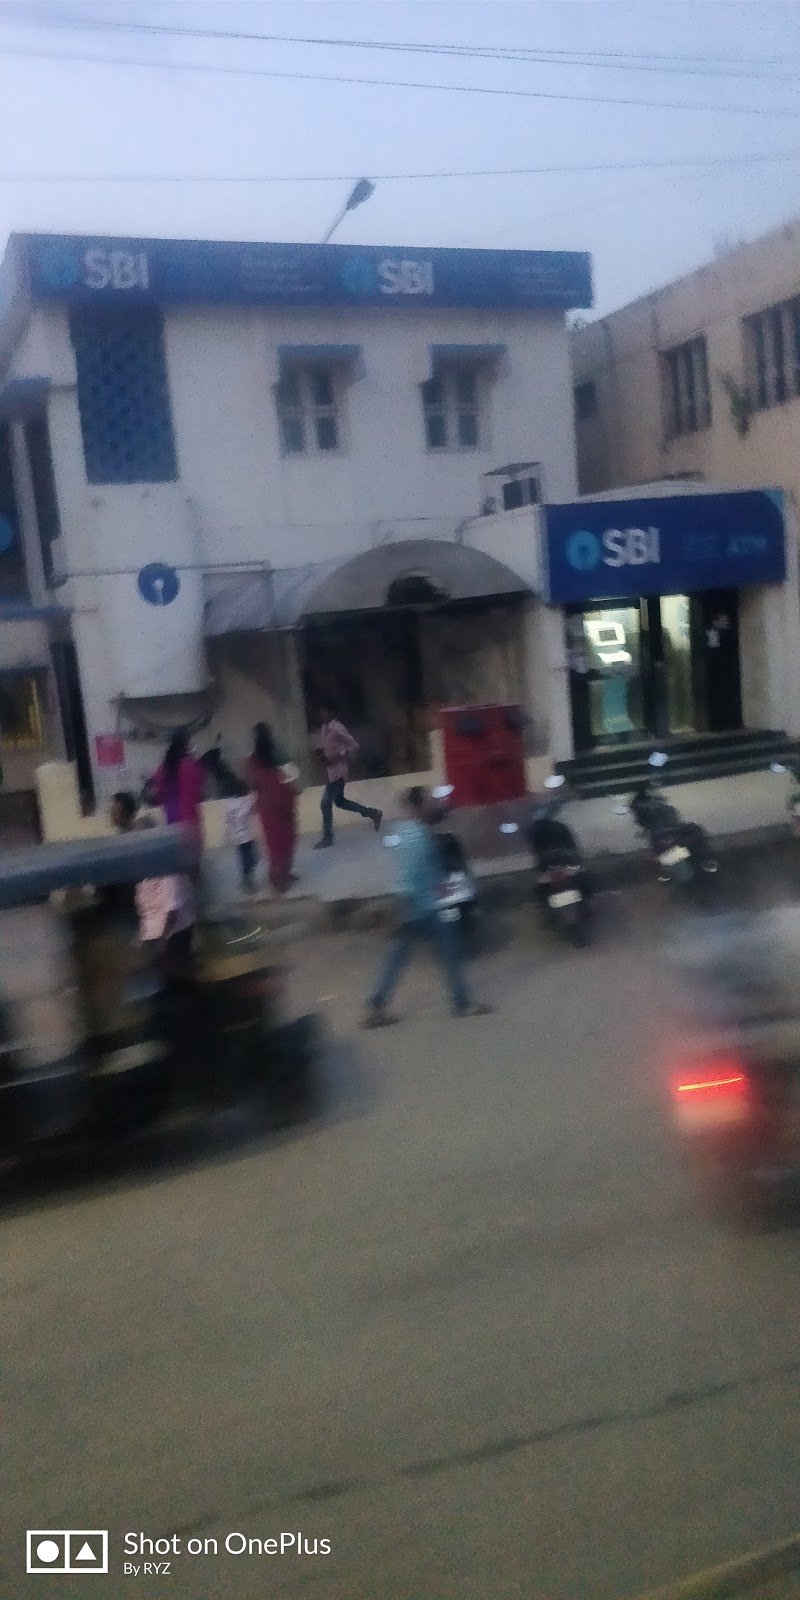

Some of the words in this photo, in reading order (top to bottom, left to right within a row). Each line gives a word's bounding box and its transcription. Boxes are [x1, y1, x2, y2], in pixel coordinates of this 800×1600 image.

[83, 250, 149, 290] SBI
[377, 259, 434, 295] SBI
[602, 527, 660, 567] SBI
